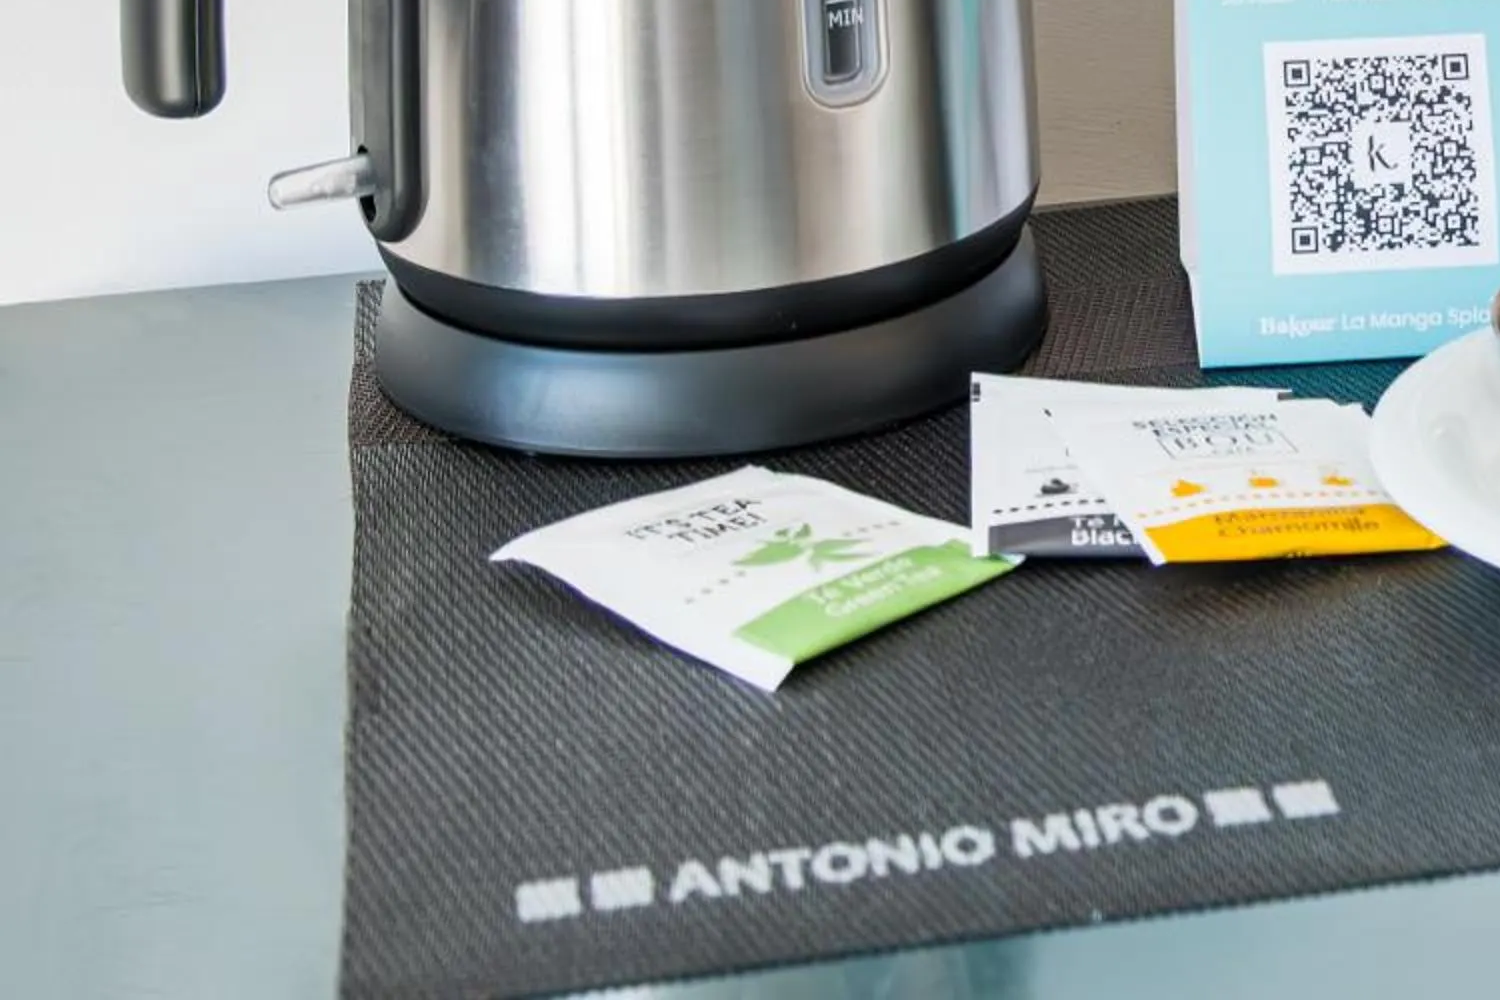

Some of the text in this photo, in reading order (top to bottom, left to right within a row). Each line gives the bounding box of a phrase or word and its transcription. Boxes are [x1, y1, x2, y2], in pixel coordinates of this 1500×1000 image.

[829, 6, 865, 29] MIN
[1340, 313, 1365, 331] La
[1370, 311, 1443, 332] Manga
[1448, 305, 1492, 329] Spla
[669, 793, 1199, 904] ANTONIO MIRO
